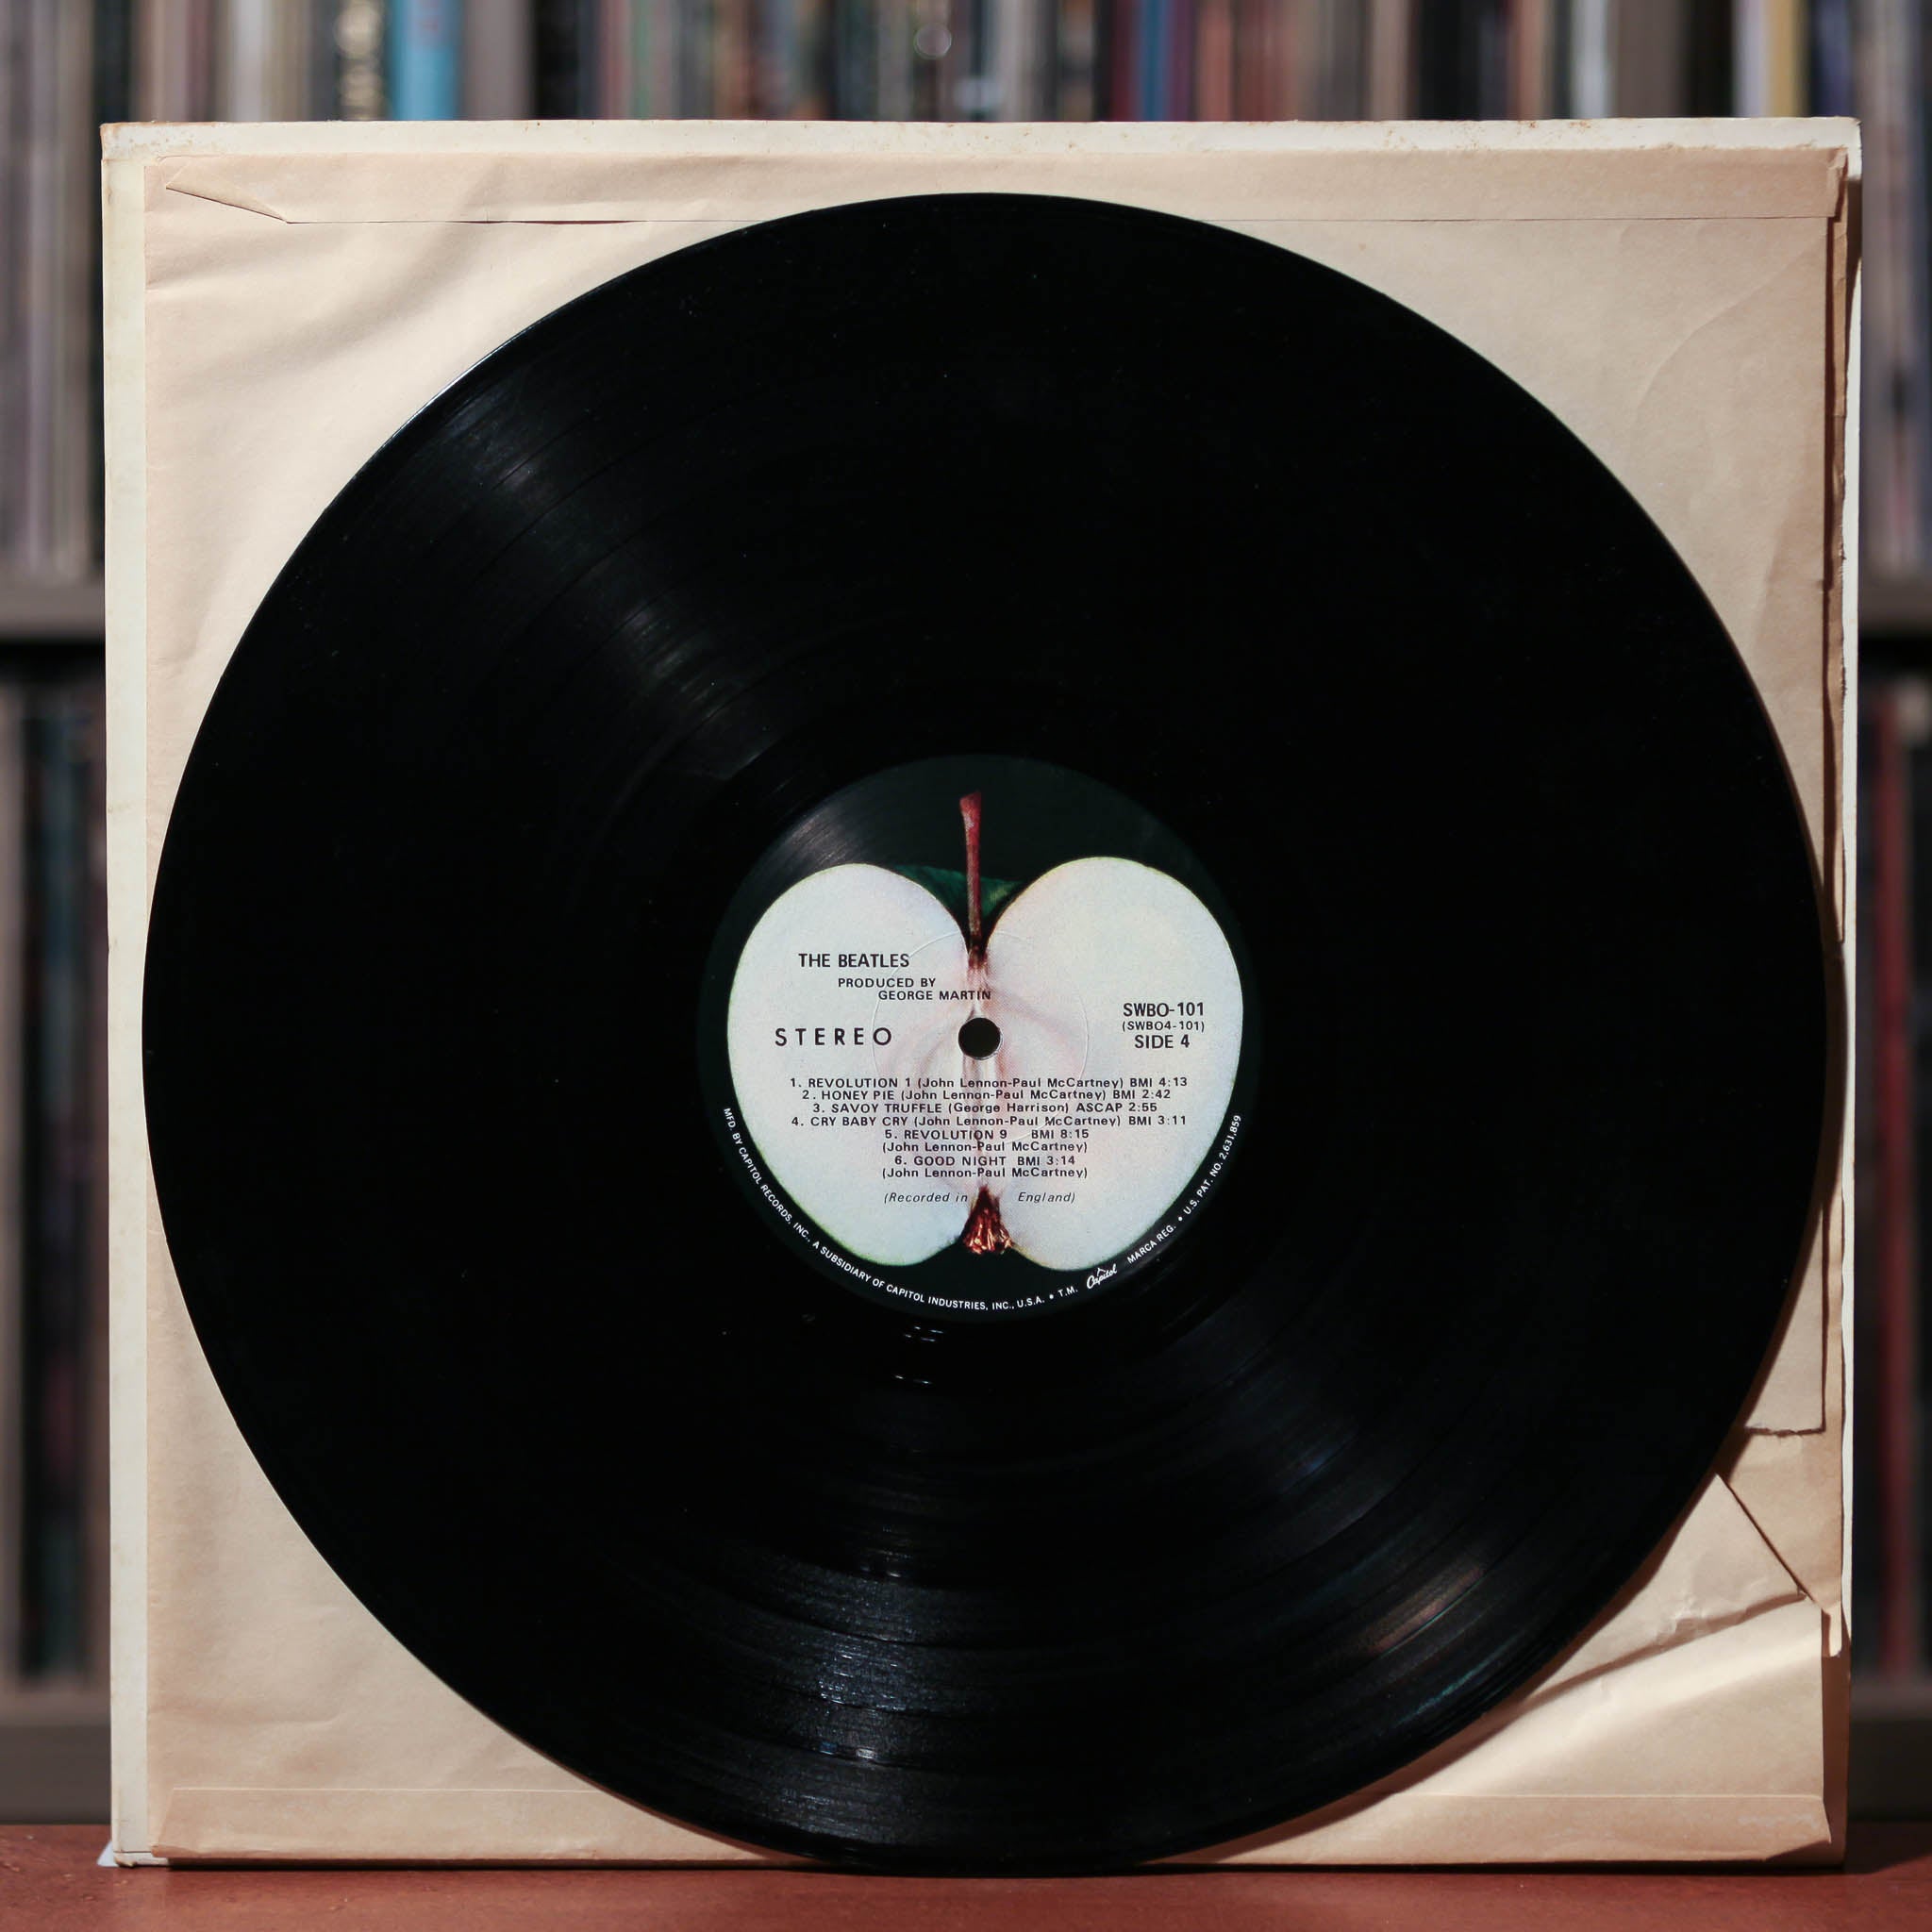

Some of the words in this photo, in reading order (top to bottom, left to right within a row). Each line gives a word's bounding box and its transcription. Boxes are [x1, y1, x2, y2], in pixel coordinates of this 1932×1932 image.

[798, 954, 830, 968] THE
[838, 953, 909, 968] BEATLES
[838, 977, 914, 988] PRODUCED
[921, 977, 936, 988] BY
[878, 991, 933, 1001] GEORGE
[939, 991, 991, 1000] MARTIN
[1123, 1002, 1205, 1017] SWBO-101
[1122, 1021, 1205, 1032] (SWBO4-101)
[774, 1027, 892, 1047] STEREO
[1134, 1035, 1174, 1049] SIDE
[1180, 1034, 1191, 1048] 4
[791, 1077, 802, 1088] 1.
[808, 1077, 898, 1088] REVOLUTION
[905, 1077, 911, 1088] 1
[917, 1077, 955, 1089] (John
[960, 1077, 1041, 1088] Lennon-Paul
[1047, 1077, 1124, 1090] McCartney)
[1130, 1077, 1153, 1087] BMI
[1158, 1077, 1188, 1087] 4:13
[802, 1090, 816, 1100] 2.
[822, 1091, 868, 1100] HONEY
[874, 1091, 894, 1100] PIE
[901, 1090, 938, 1102] (John
[943, 1090, 1024, 1100] Lennon-Paul
[1030, 1090, 1106, 1102] McCartney)
[1112, 1090, 1136, 1100] BMI
[1141, 1090, 1171, 1099] 2:42
[813, 1103, 825, 1113] 3.
[831, 1103, 879, 1113] SAVOY
[884, 1103, 942, 1113] TRUFFLE
[948, 1103, 1000, 1115] (George
[1007, 1103, 1069, 1115] Harrison)
[1076, 1103, 1123, 1113] ASCAP
[1128, 1103, 1158, 1112] 2:55
[791, 1116, 804, 1126] 4.
[810, 1117, 837, 1126] CRY
[841, 1117, 876, 1126] BABY
[882, 1117, 908, 1126] CRY
[914, 1116, 950, 1128] (John
[956, 1116, 1039, 1126] Lennon-Paul
[1044, 1116, 1121, 1128] McCartney)
[1128, 1116, 1152, 1125] BMI
[1158, 1116, 1186, 1125] 3:11
[885, 1129, 897, 1140] 5.
[904, 1130, 994, 1140] REVOLUTION
[1000, 1129, 1008, 1140] 9
[1031, 1129, 1055, 1140] BMI
[1060, 1129, 1090, 1139] 8:15
[882, 1142, 919, 1154] (John
[924, 1142, 1005, 1152] Lennon-Paul
[1011, 1142, 1088, 1154] McCartney)
[894, 1156, 907, 1166] 6.
[913, 1156, 956, 1166] GOOD
[961, 1156, 1007, 1166] NIGHT
[1017, 1156, 1041, 1166] BMI
[1046, 1156, 1075, 1165] 3:14
[882, 1168, 919, 1180] (John
[924, 1168, 1005, 1178] Lennon-Paul
[1011, 1168, 1088, 1180] McCartney)
[884, 1192, 950, 1203] (Recorded
[956, 1192, 968, 1203] in
[1018, 1192, 1075, 1204] England)
[724, 1108, 736, 1131] MFD.
[732, 1132, 742, 1144] BY
[739, 1147, 762, 1185] CAPITOL
[812, 1241, 820, 1249] A
[820, 1246, 872, 1282] SUBSIDIARY
[872, 1278, 885, 1288] OF
[886, 1284, 924, 1303] CAPITOL
[1017, 1295, 1045, 1308] U.S.A.
[1058, 1285, 1078, 1297] T.M.
[1087, 1263, 1117, 1289] Capitol
[1127, 1241, 1157, 1264] MARCA
[1156, 1224, 1176, 1241] REG.
[1183, 1199, 1200, 1215] U.S.
[1196, 1179, 1213, 1197] PAT.
[1209, 1162, 1224, 1177] NO.
